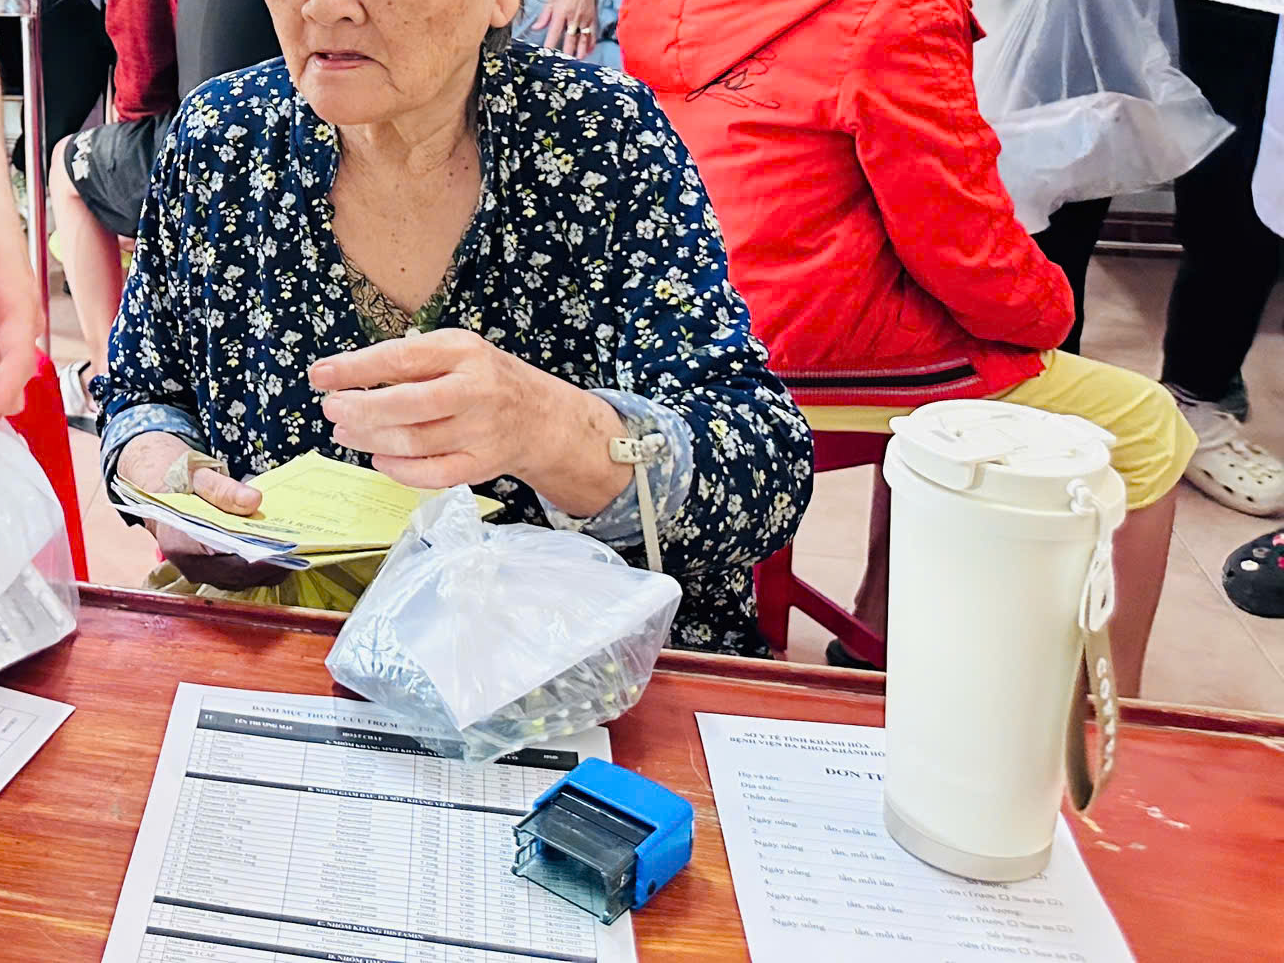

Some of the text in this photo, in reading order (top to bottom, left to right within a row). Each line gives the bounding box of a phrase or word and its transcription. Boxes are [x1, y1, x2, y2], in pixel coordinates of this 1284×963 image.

[809, 737, 846, 748] KHÁNH
[800, 744, 830, 753] KHOA
[831, 745, 868, 756] KHÁNH
[870, 748, 886, 758] HÒ
[825, 766, 861, 779] ĐƠN
